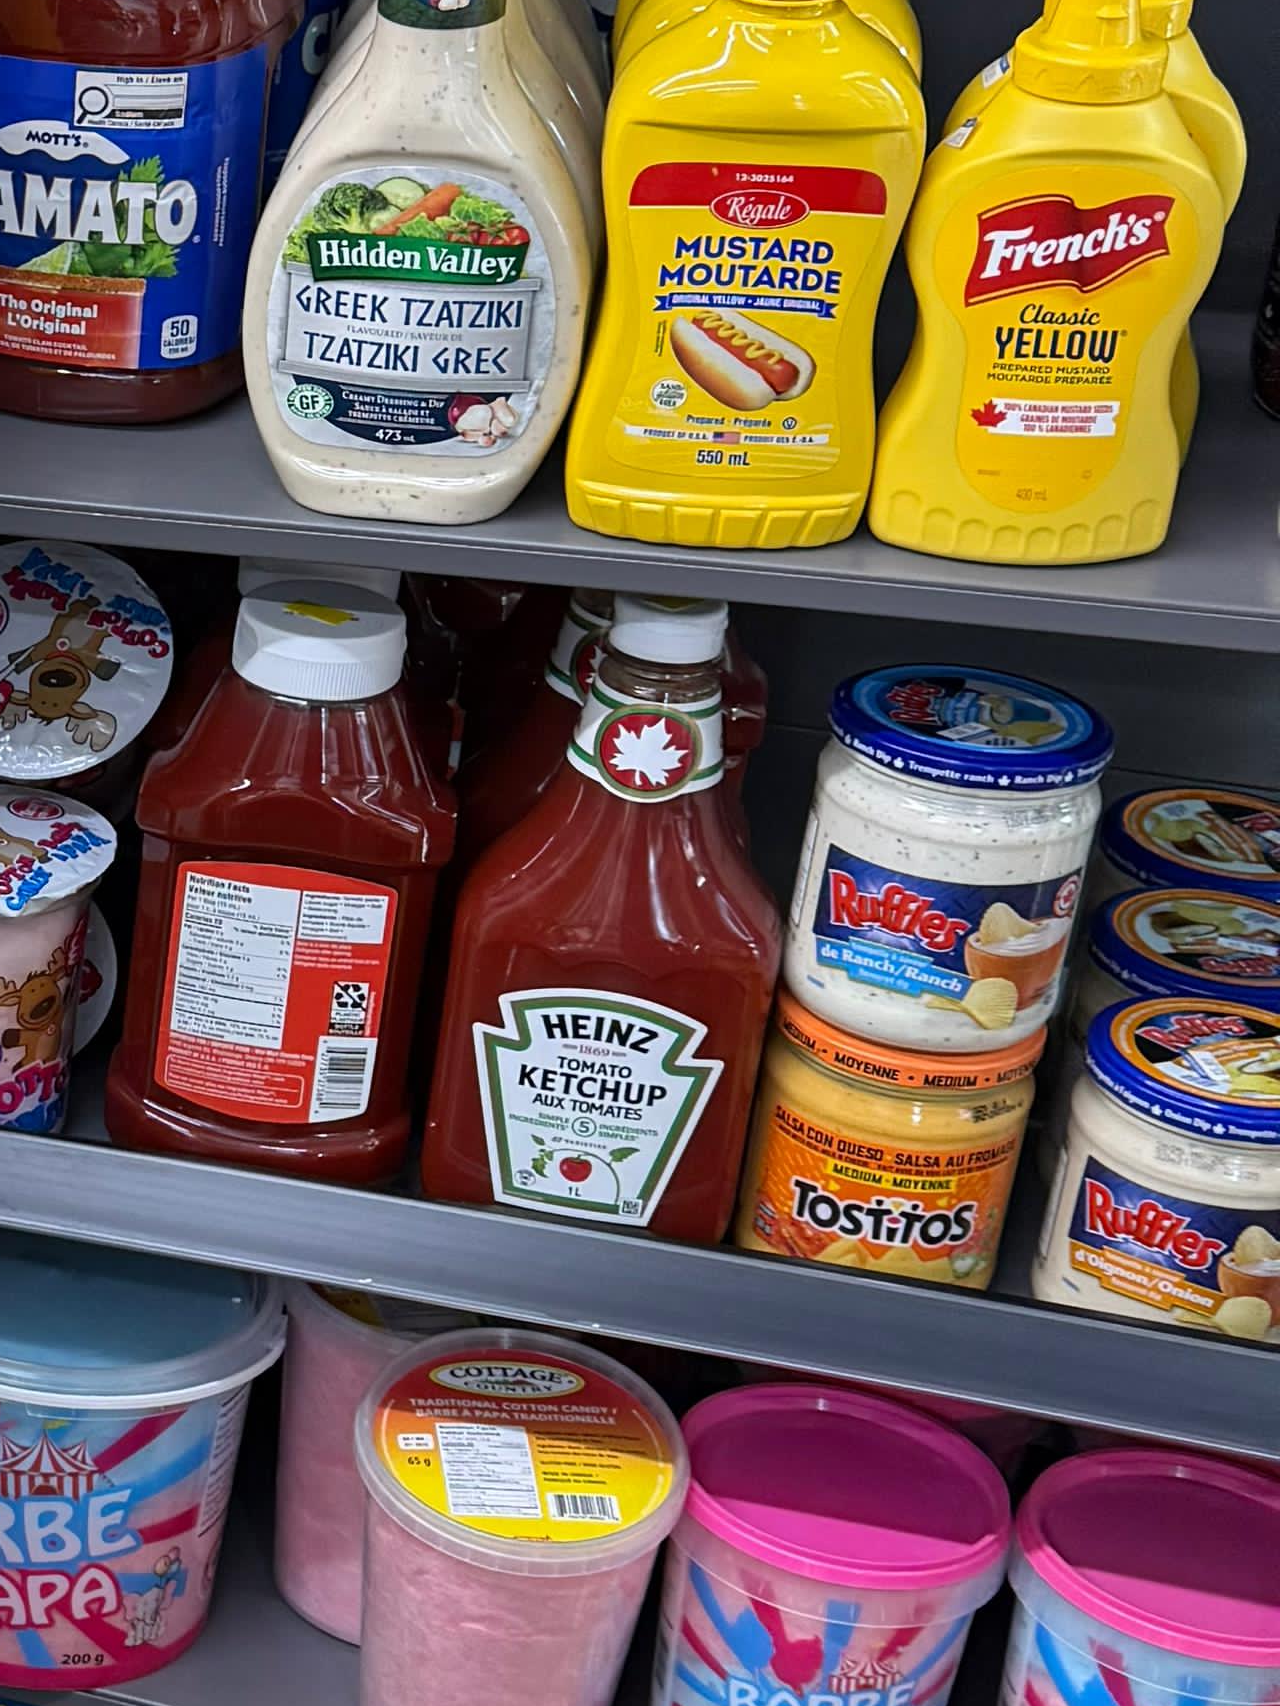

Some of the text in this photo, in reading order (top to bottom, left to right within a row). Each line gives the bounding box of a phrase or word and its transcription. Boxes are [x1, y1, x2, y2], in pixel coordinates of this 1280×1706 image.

[26, 130, 82, 147] MOTT'S
[725, 195, 793, 229] Régale
[318, 240, 421, 270] Hidden
[675, 235, 834, 264] MUSTARD
[980, 212, 1152, 280] French's
[30, 296, 98, 318] Original
[296, 285, 523, 328] GREEK TZATZIKI
[1019, 304, 1101, 327] Classic
[994, 327, 1120, 363] YELLOW
[828, 869, 973, 954] Ruffles
[541, 1014, 659, 1053] HEINZ
[518, 1064, 667, 1107] KETCHUP
[450, 1366, 562, 1384] COTTAGE
